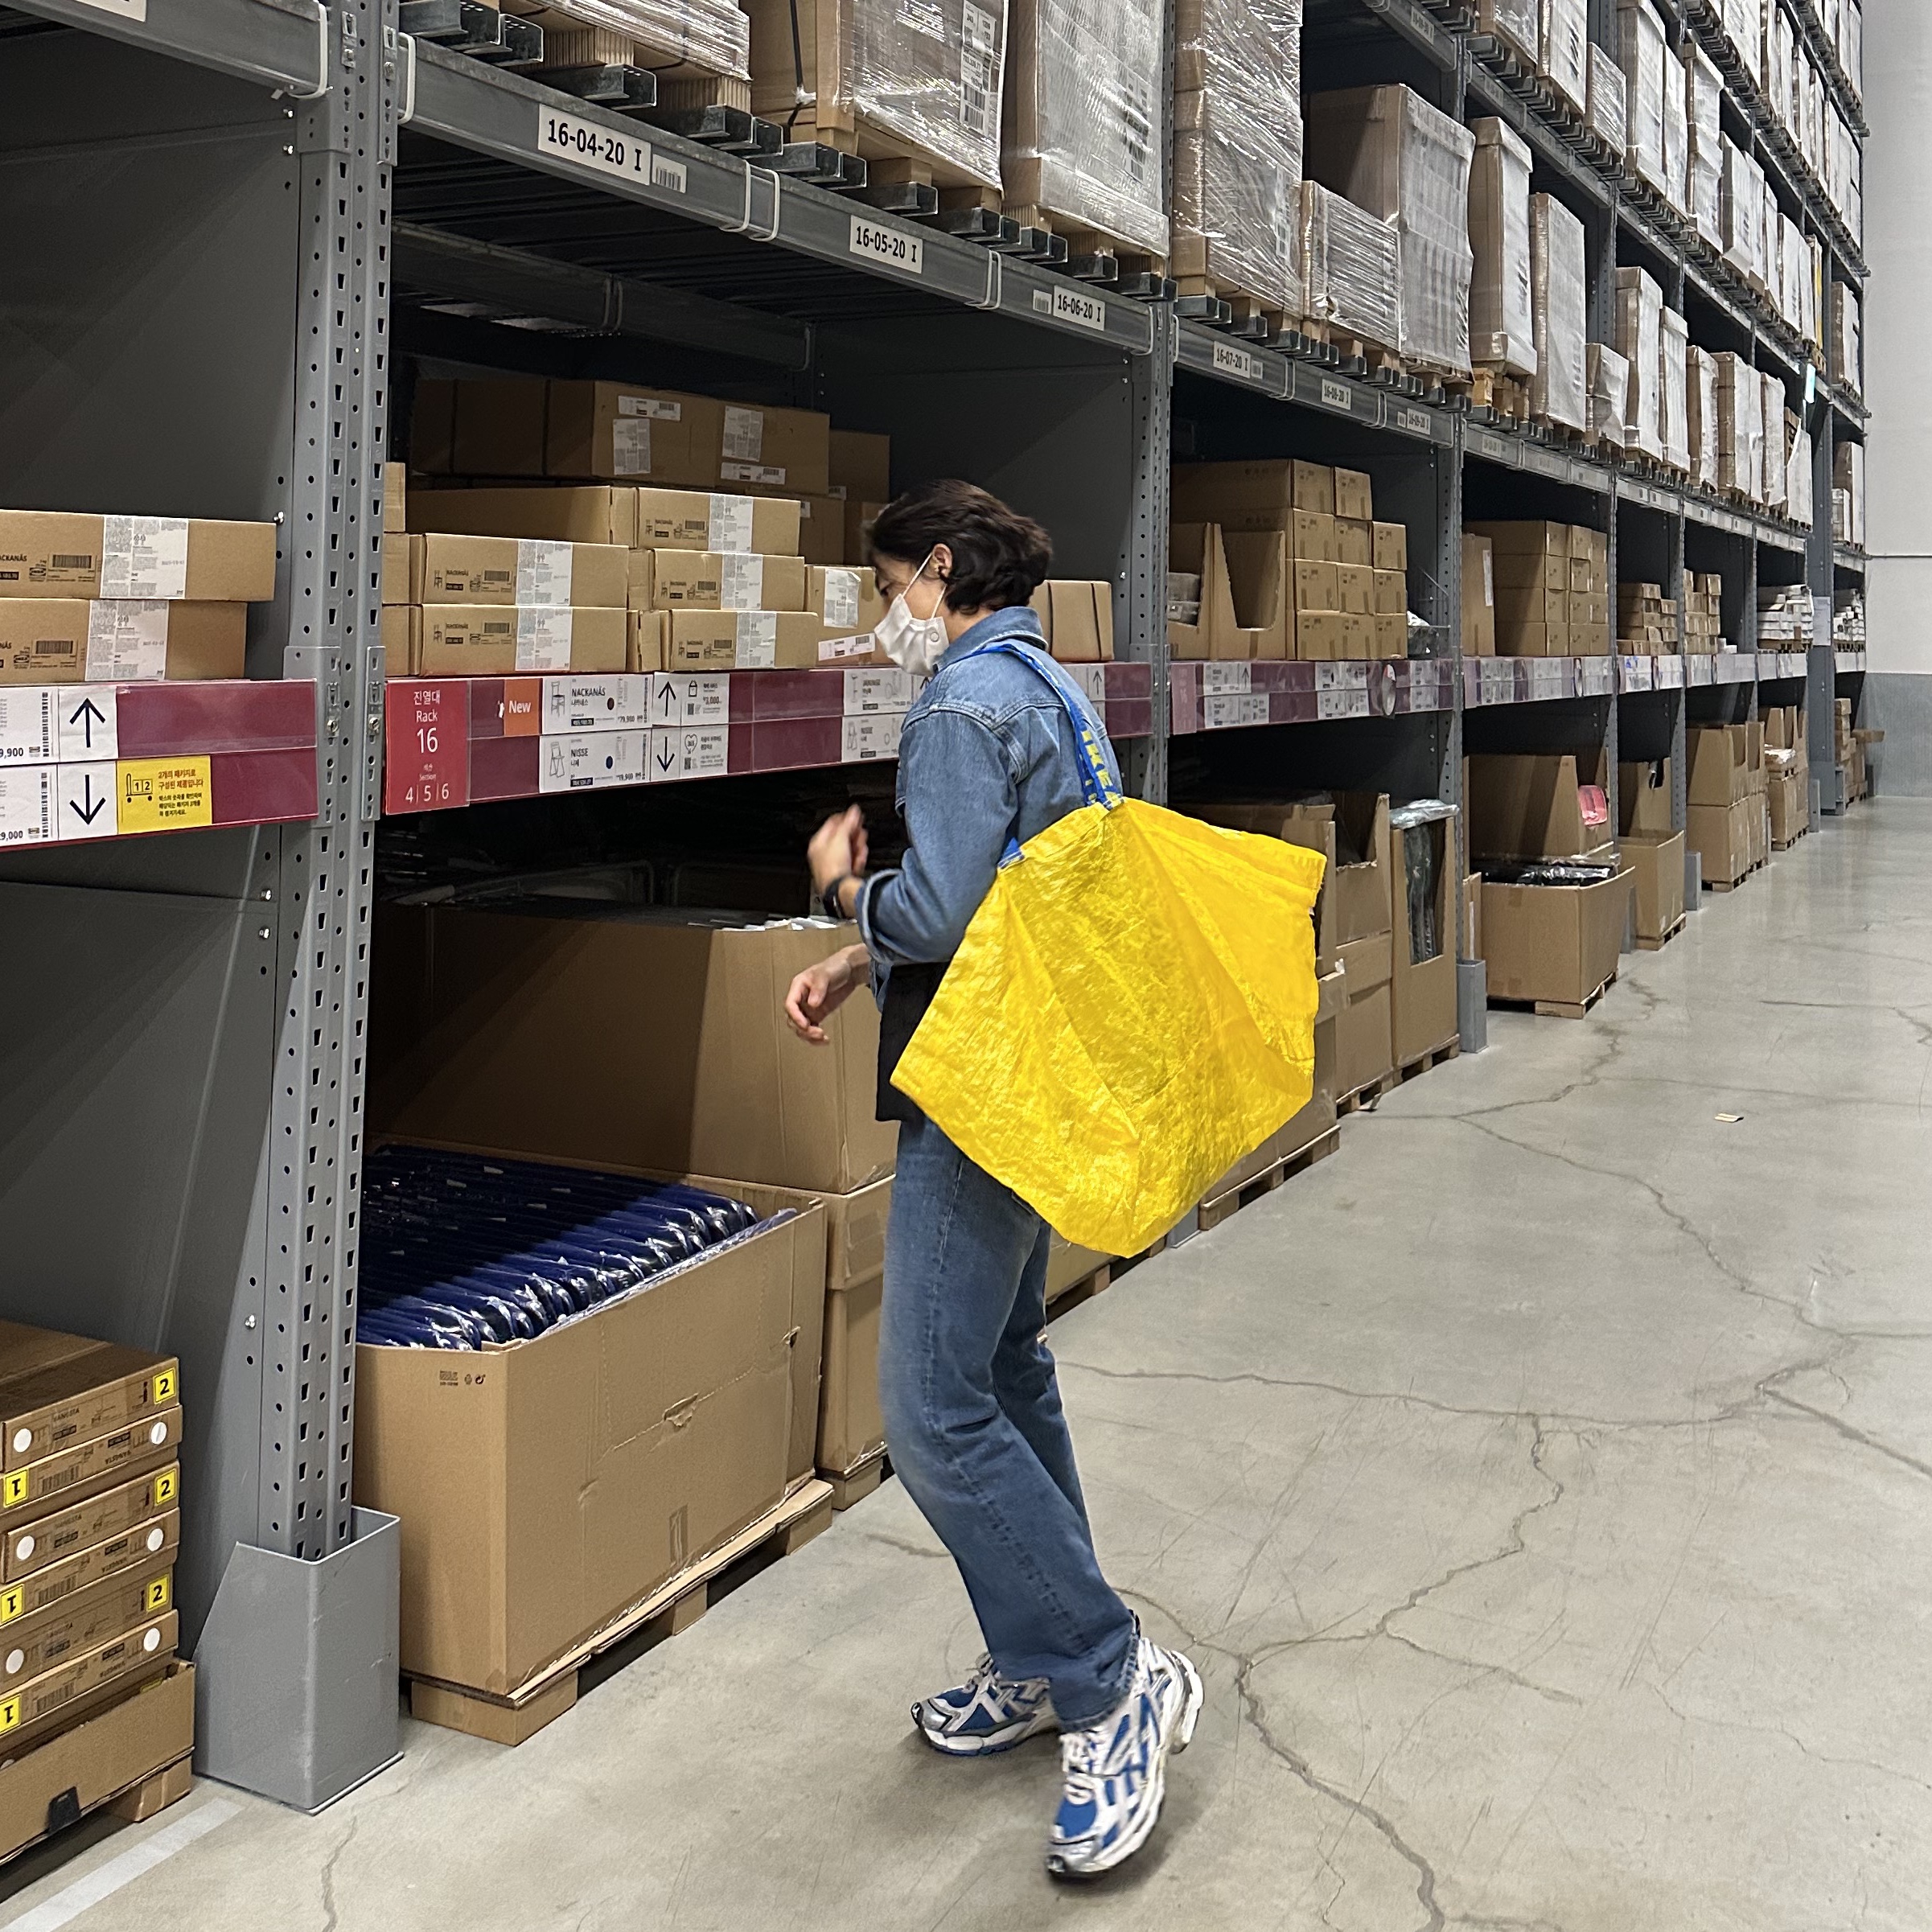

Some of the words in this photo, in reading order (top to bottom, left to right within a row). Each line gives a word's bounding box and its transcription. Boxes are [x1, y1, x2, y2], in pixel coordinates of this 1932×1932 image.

[549, 119, 624, 166] 16-04-20
[635, 149, 642, 171] I
[857, 226, 905, 259] 16-05-20
[1058, 294, 1093, 319] 16-06-20
[1217, 348, 1242, 369] 16-07-20
[413, 690, 441, 705] 진열대
[416, 709, 438, 723] Rack
[508, 701, 532, 714] New
[417, 727, 438, 754] 16
[570, 747, 589, 757] NISSE
[135, 782, 139, 791] 1
[145, 781, 150, 790] 2
[405, 787, 413, 804] 4
[423, 785, 432, 802] 5
[442, 783, 449, 800] 6
[160, 1378, 170, 1396] 2
[11, 1478, 21, 1496] 1
[161, 1479, 171, 1497] 2
[153, 1585, 162, 1603] 2
[7, 1594, 17, 1613] 1
[4, 1704, 14, 1724] 1
